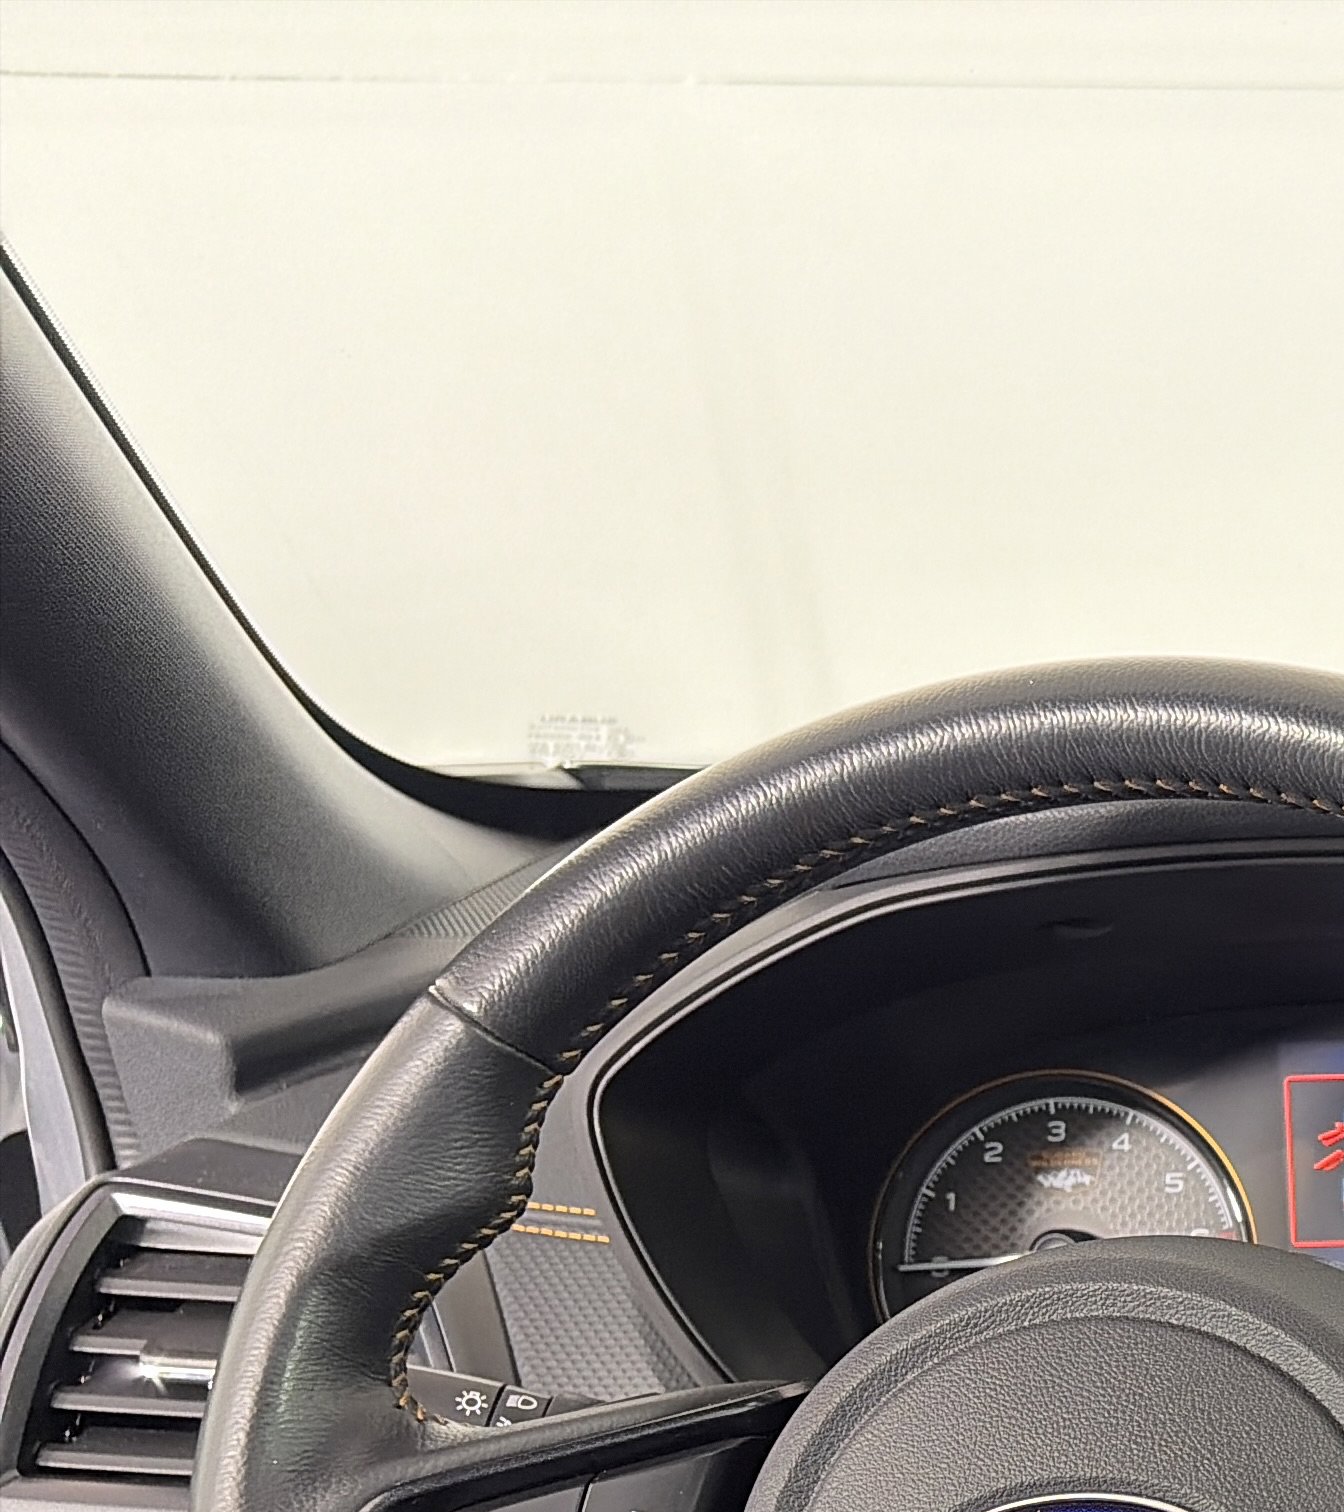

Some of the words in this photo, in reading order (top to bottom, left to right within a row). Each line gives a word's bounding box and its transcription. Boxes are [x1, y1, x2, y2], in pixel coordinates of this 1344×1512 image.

[1046, 1120, 1067, 1142] 3
[983, 1141, 1004, 1162] 2
[1112, 1132, 1132, 1153] 4
[1165, 1172, 1184, 1194] 5
[946, 1191, 957, 1211] 1
